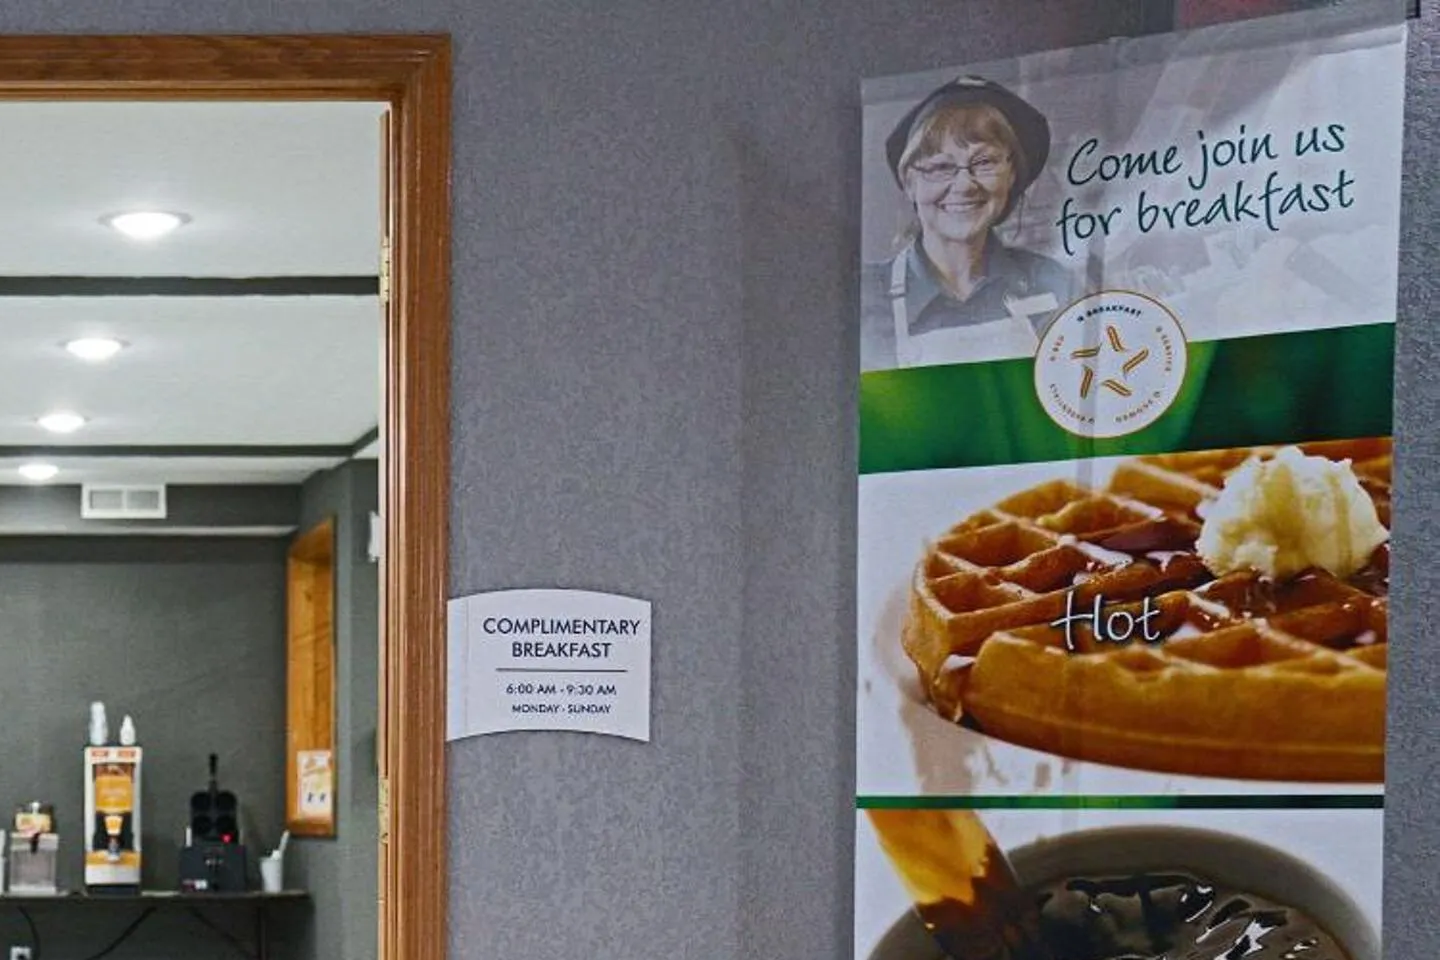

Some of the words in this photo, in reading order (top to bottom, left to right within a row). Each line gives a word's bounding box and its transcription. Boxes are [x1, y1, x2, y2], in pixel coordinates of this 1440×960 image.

[1067, 138, 1182, 185] Come
[1188, 124, 1278, 190] join
[1295, 124, 1345, 156] us
[1056, 198, 1121, 256] for
[1137, 169, 1356, 233] breakfast
[483, 618, 640, 635] COMPLIMENTARY
[1050, 589, 1160, 650] Hot
[512, 642, 612, 658] BREAKFAST
[506, 683, 533, 695] 6:00
[537, 684, 557, 695] AM
[566, 684, 594, 696] 9:30
[597, 684, 617, 696] AM
[512, 704, 560, 714] MONDAY
[567, 704, 611, 714] SUNDAY
